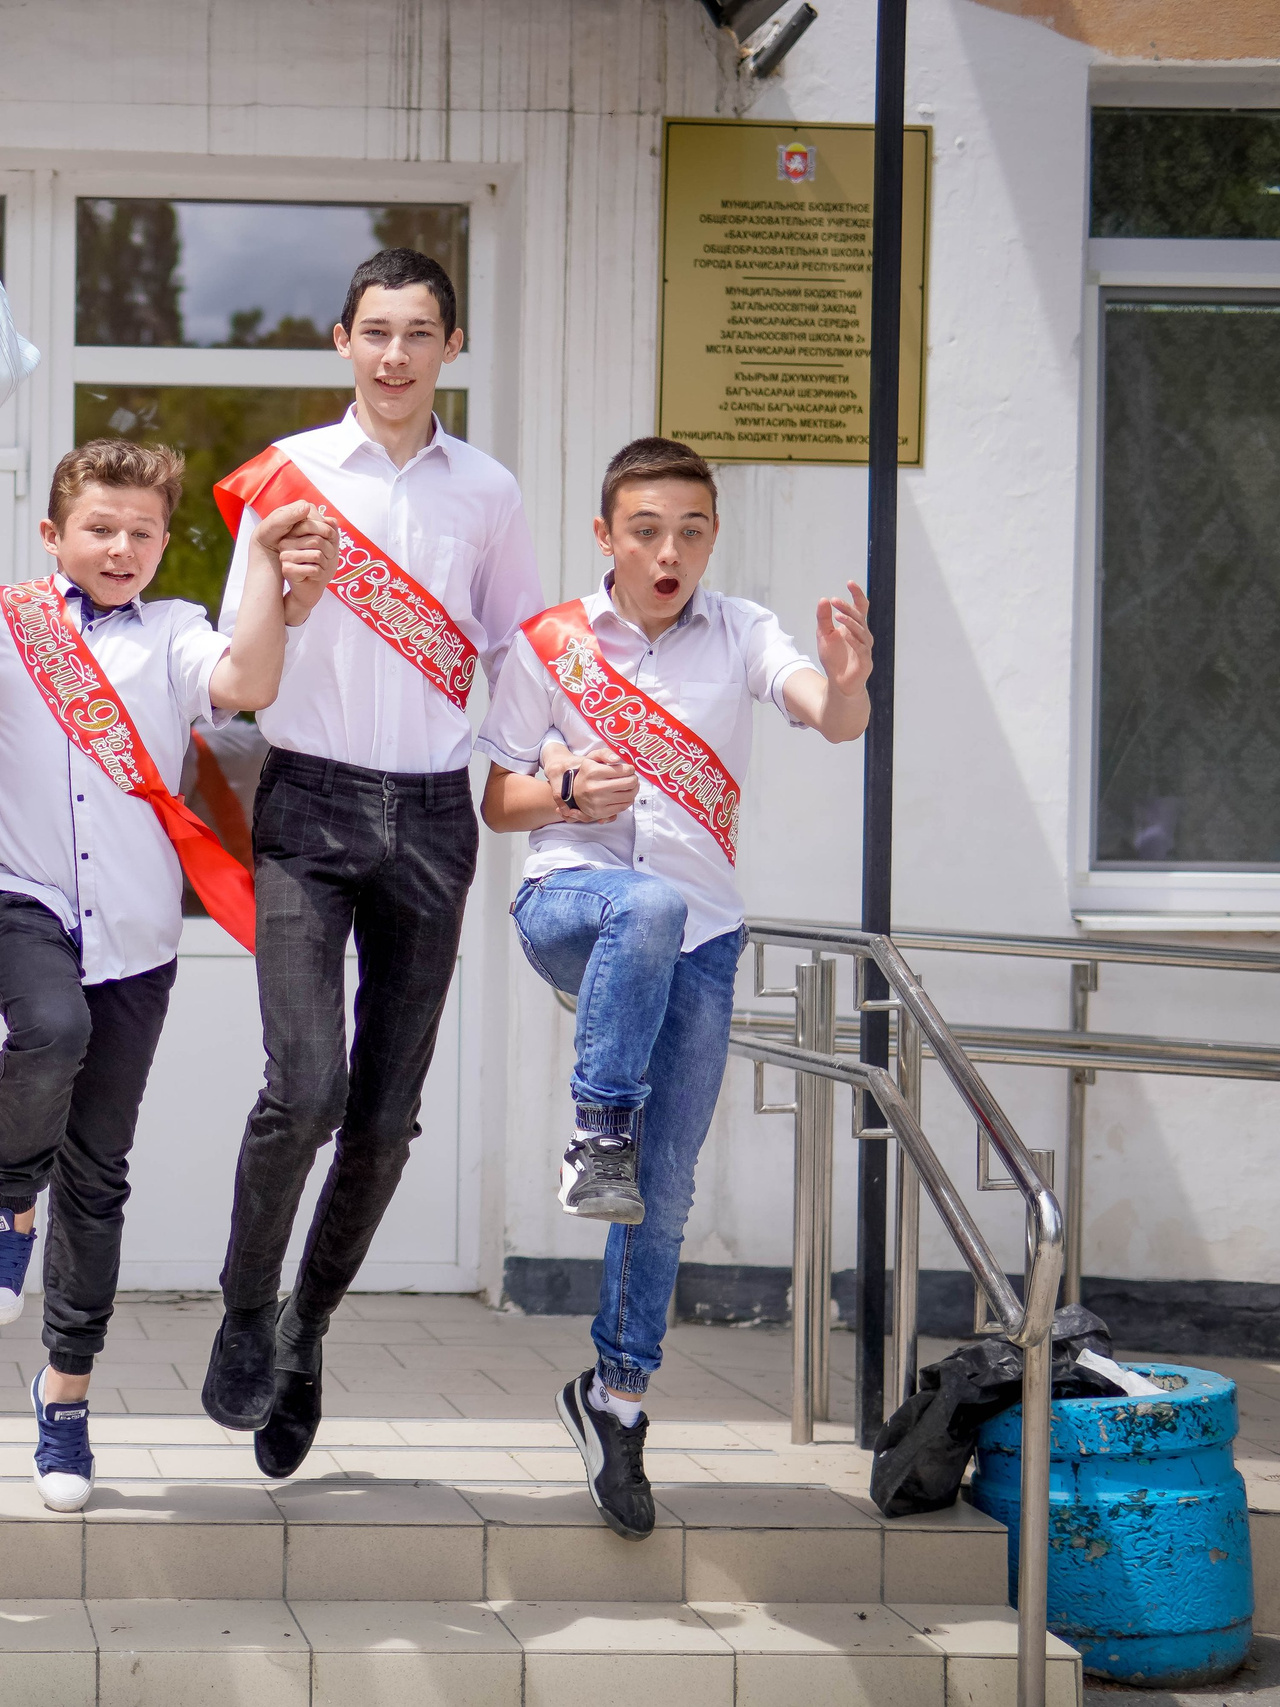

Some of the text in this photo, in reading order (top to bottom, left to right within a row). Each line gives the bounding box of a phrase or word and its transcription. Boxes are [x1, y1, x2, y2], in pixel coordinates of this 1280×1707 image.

[721, 200, 870, 213] МУНИЦИПАЛЬНОЕ БЮДЖЕТНОЕ
[699, 213, 873, 229] ОБЩЕОБРАЗОВАТЕЛЬНОЕ УЧРЕЖДЕ
[821, 232, 866, 243] СРЕДНЯЯ
[703, 243, 828, 258] ОБЩЕОБРАЗОВАТЕЛЬНАЯ
[831, 247, 865, 258] ШКОЛА
[693, 259, 732, 270] ГОРОДА
[735, 260, 799, 271] БАХЧИСАРАЙ
[802, 262, 865, 273] РЕСПУБЛИКИ
[821, 304, 856, 315] ЗАКЛАД
[818, 318, 859, 329] СЕРЕДНЯ
[808, 332, 841, 342] ШКОЛА
[735, 344, 796, 355] БАХЧИСАРАЙ
[855, 349, 871, 358] КРИ
[839, 404, 863, 415] ОРТА
[671, 430, 735, 441] МУНИЦИПАЛЬ
[738, 431, 778, 443] БЮДЖЕТ
